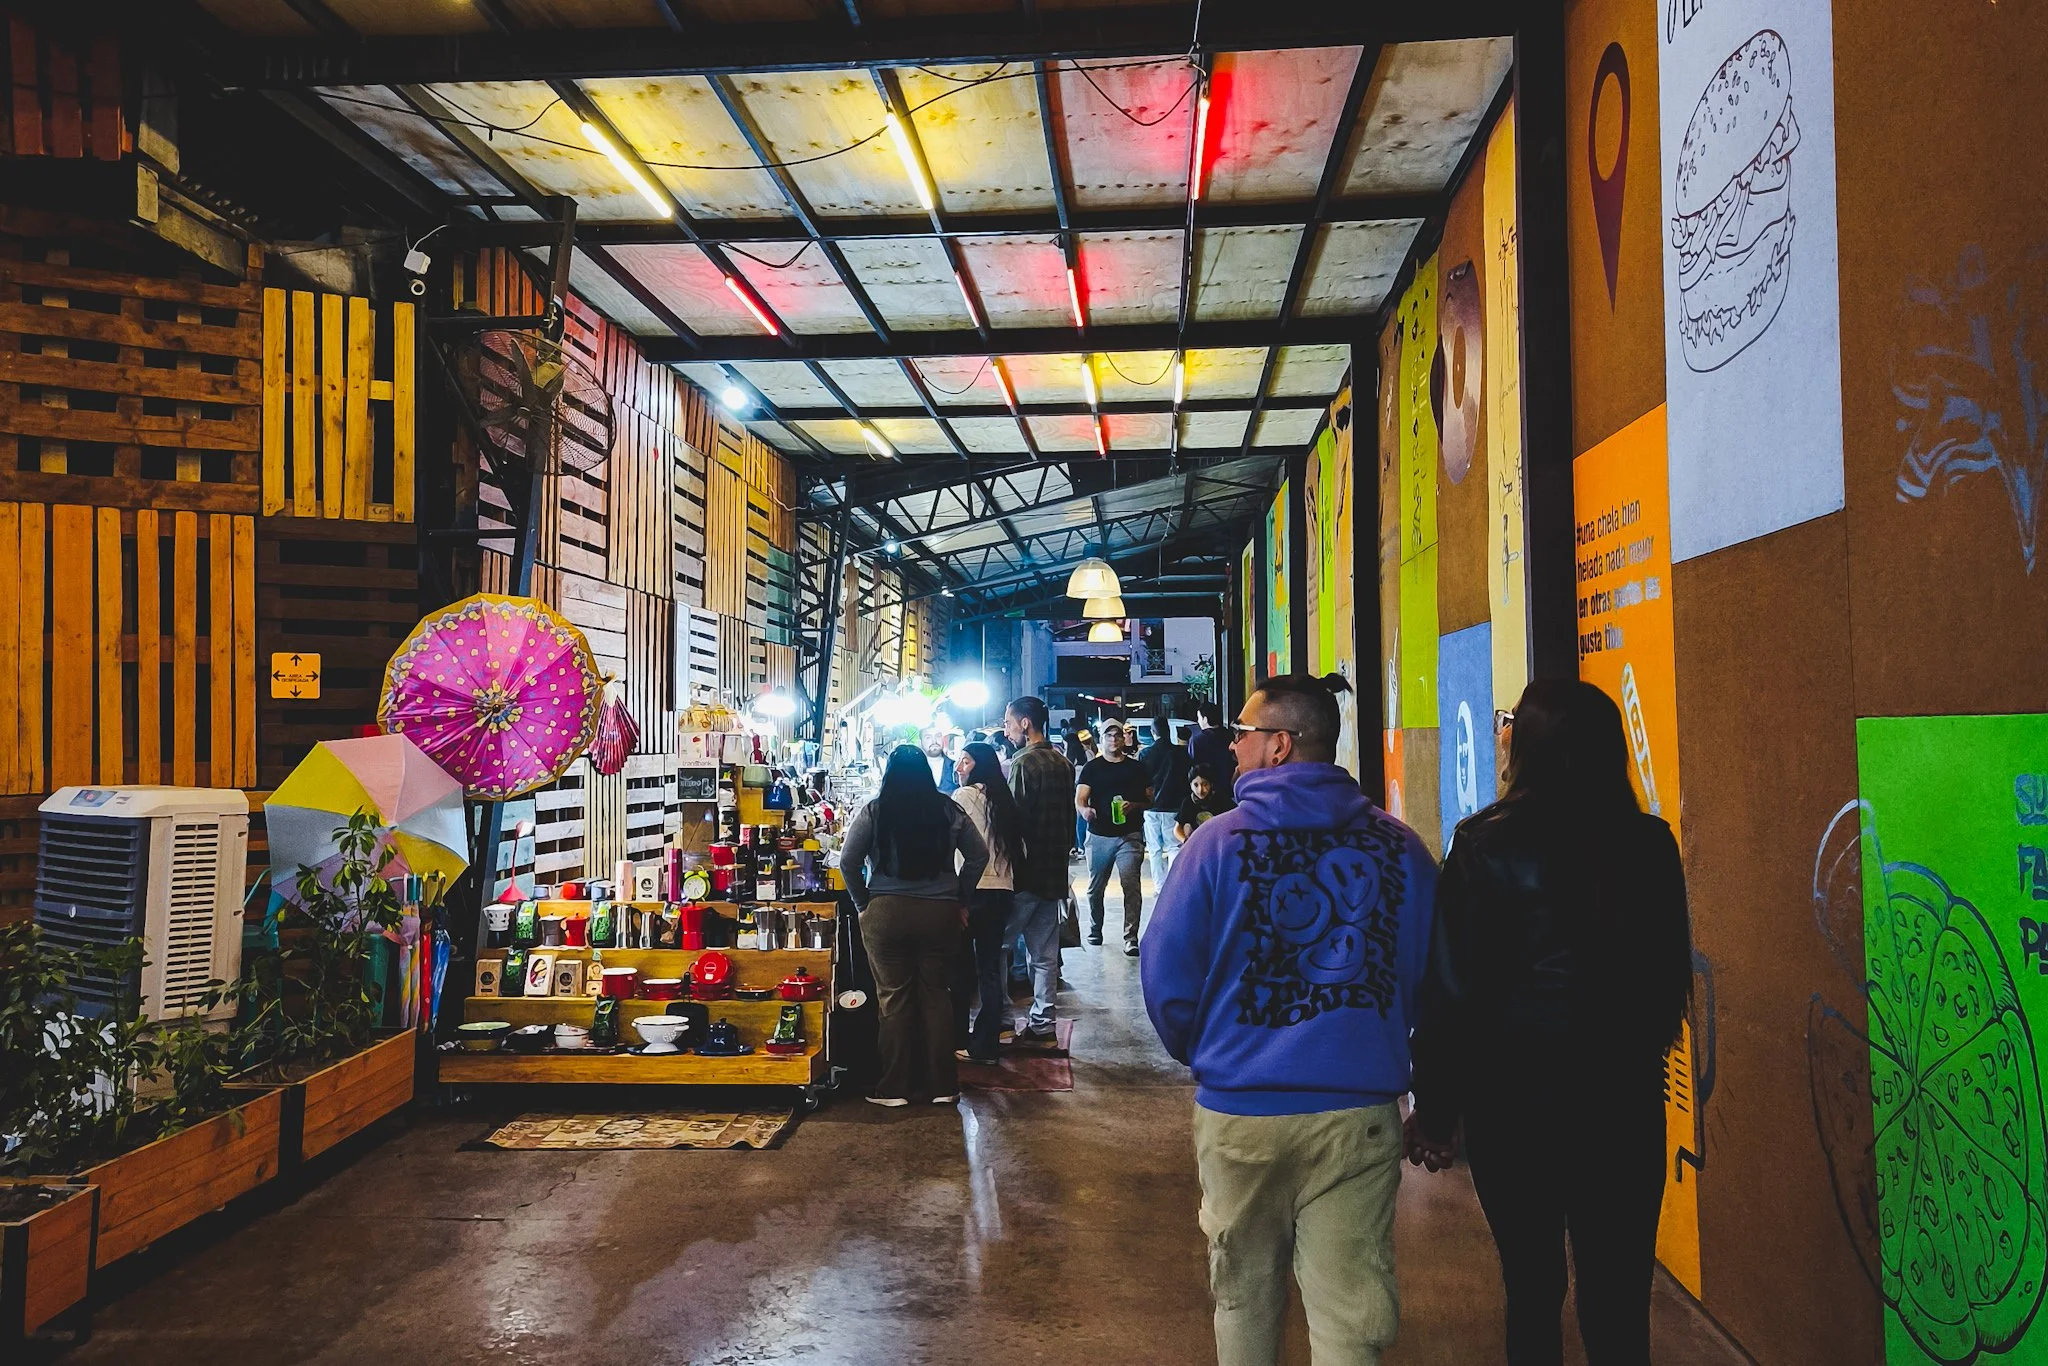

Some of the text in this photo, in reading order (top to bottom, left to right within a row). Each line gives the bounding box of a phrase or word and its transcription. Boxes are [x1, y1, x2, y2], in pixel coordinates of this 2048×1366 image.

[1597, 504, 1620, 538] chela
[1622, 497, 1641, 526] bien
[1577, 549, 1603, 583] helada
[1605, 541, 1627, 575] nada
[1578, 596, 1589, 618] en
[1590, 588, 1612, 616] otras
[1579, 626, 1603, 661] gusta
